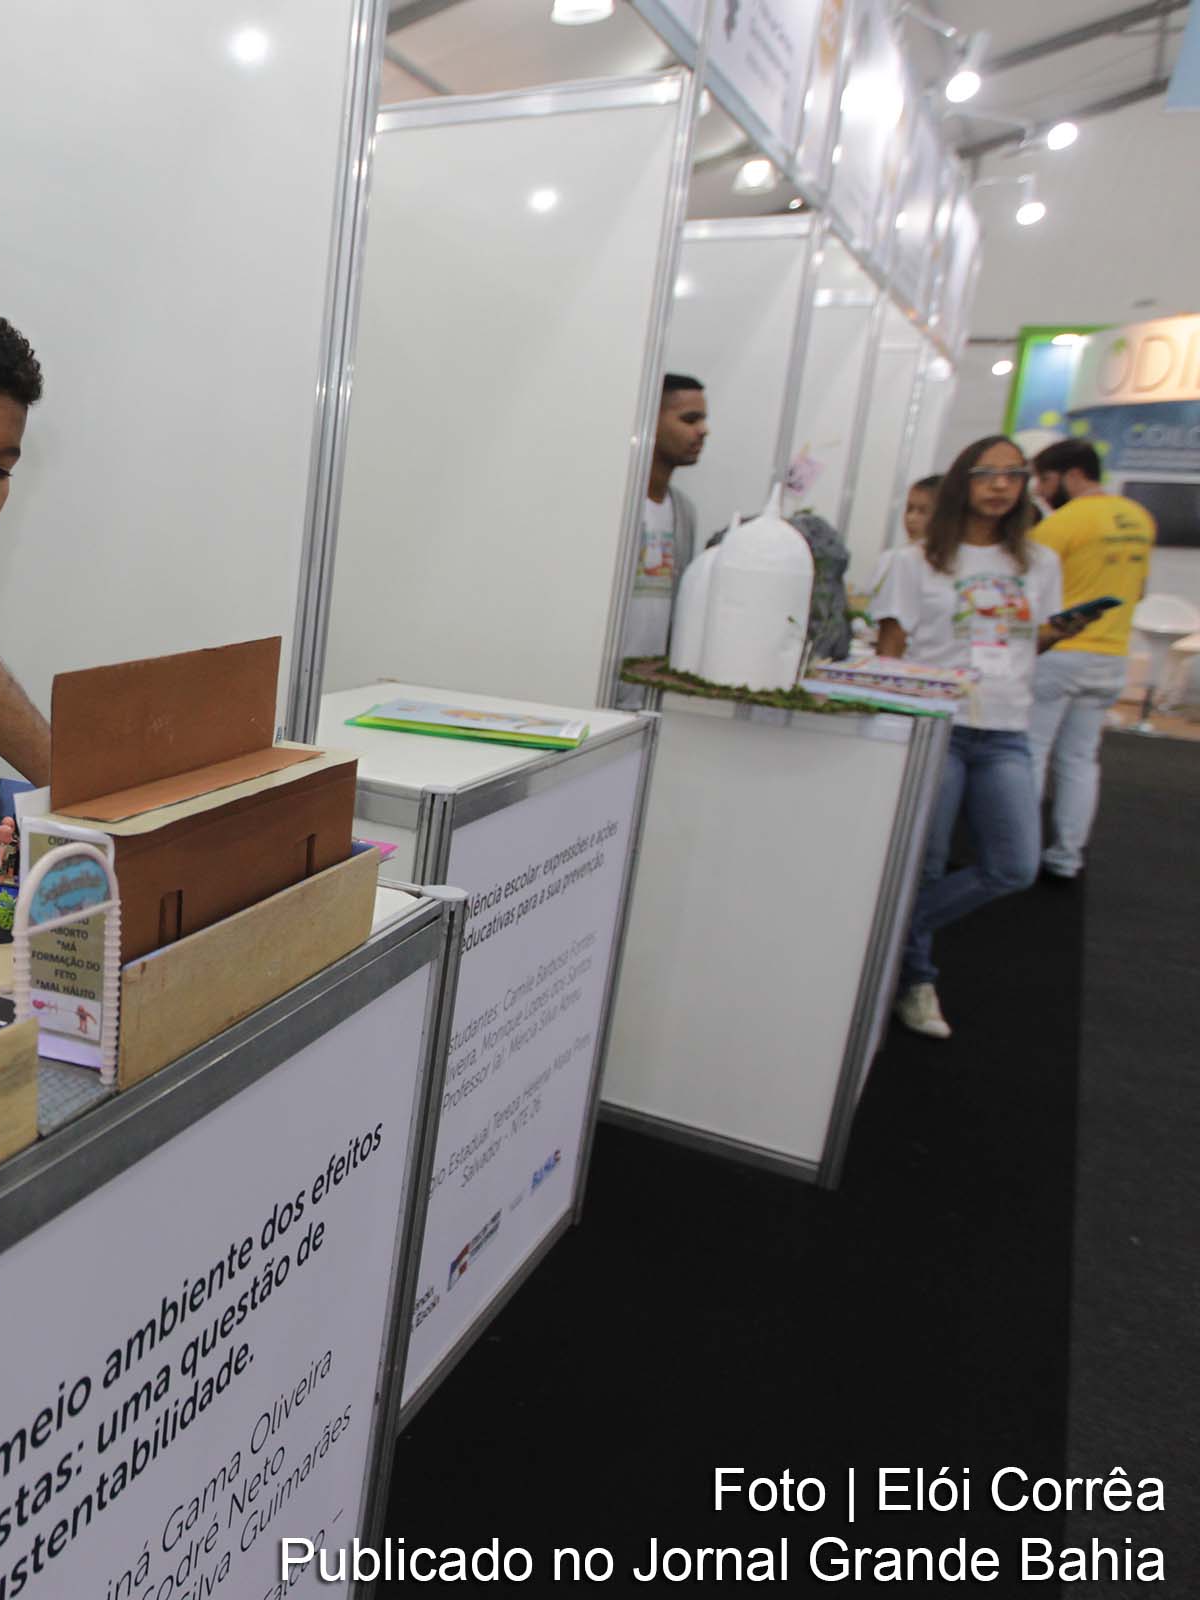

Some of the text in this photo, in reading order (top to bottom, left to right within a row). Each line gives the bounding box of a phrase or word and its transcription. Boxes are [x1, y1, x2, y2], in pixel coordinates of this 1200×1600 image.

[31, 950, 100, 972] FORMAÇÃO DO
[54, 968, 78, 981] FETO
[516, 896, 538, 926] para
[103, 1236, 254, 1390] ambiente
[261, 1189, 306, 1251] dos
[312, 1122, 383, 1205] efeitos
[97, 1364, 171, 1455] uma
[181, 1255, 291, 1379] questão
[297, 1220, 326, 1267] de
[162, 1450, 241, 1553] Gama
[251, 1350, 332, 1454] Oliveira
[181, 1404, 351, 1600] ilva Guimarães
[228, 1445, 286, 1529] Neto
